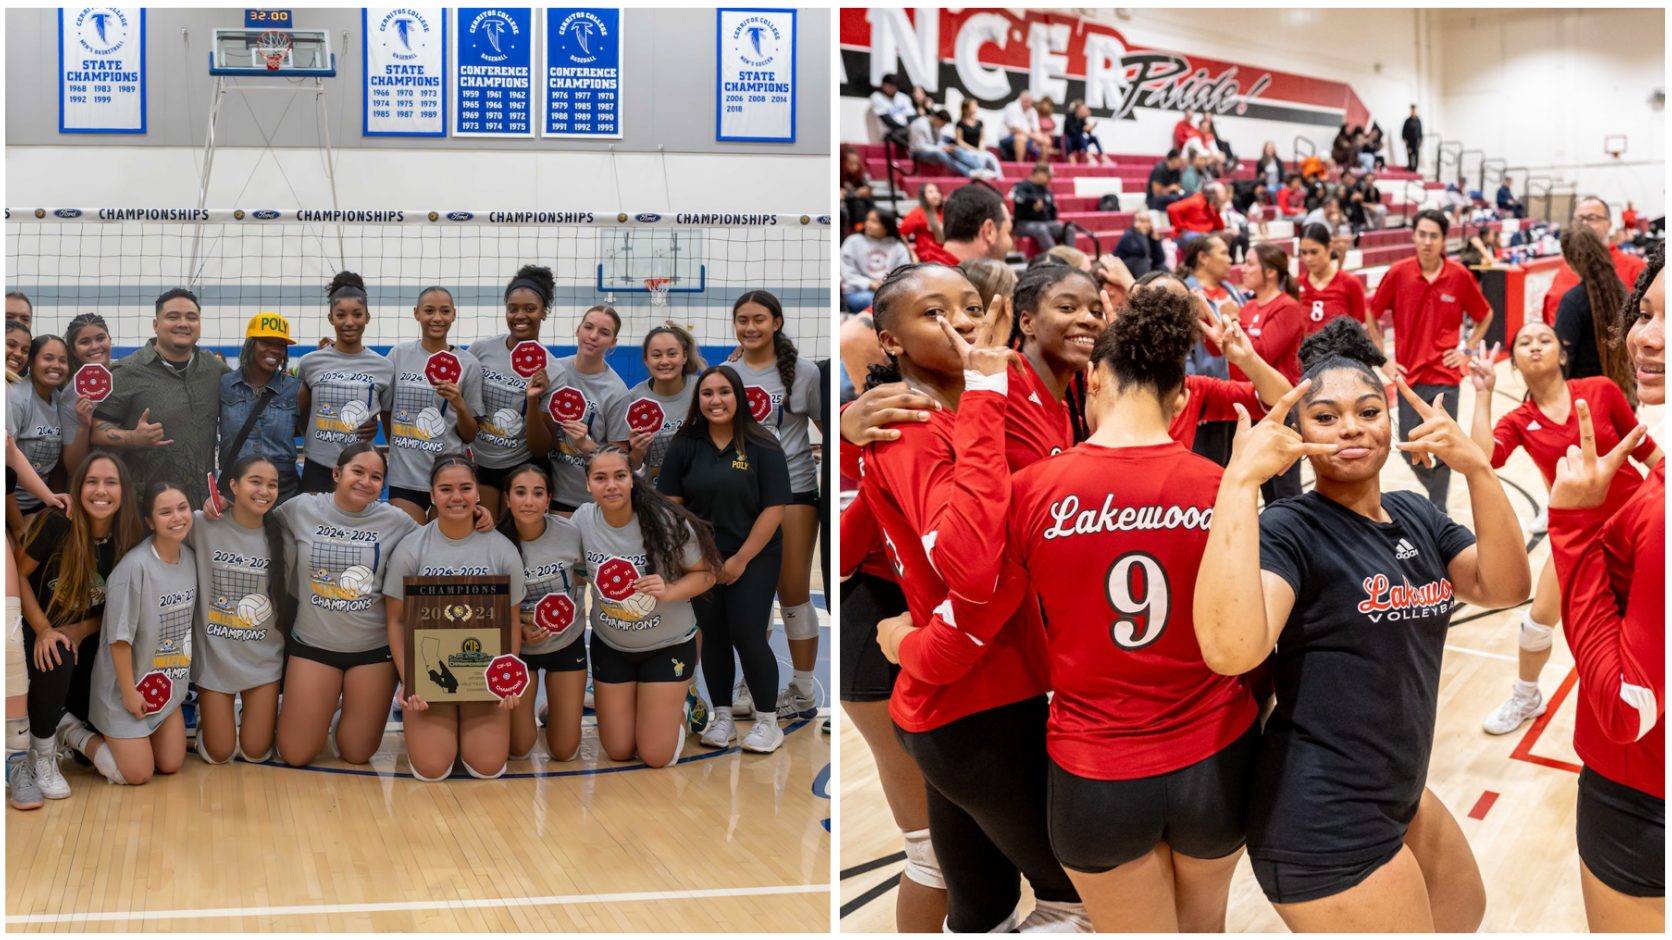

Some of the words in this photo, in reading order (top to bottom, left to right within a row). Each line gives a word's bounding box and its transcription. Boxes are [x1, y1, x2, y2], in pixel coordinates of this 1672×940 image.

[251, 12, 288, 20] 32.00
[380, 9, 406, 32] CERRITOS
[407, 9, 429, 32] COLLEGE
[470, 10, 496, 33] CERRITOS
[497, 11, 519, 35] COLLEGE
[559, 12, 584, 35] CERRITOS
[586, 12, 608, 36] COLLEGE
[733, 17, 758, 39] CERRITOS
[760, 18, 780, 40] COLLEGE
[392, 52, 418, 60] BASEBALL
[481, 53, 508, 61] BASEBALL
[570, 55, 596, 63] BASEBALL
[840, 8, 1128, 110] NCER
[83, 60, 122, 70] STATE
[386, 65, 424, 74] STATE
[67, 71, 138, 81] CHAMPIONS
[460, 66, 528, 76] CONFERENCE
[550, 67, 616, 77] CONFERENCE
[739, 71, 775, 81] STATE
[371, 76, 439, 86] CHAMPIONS
[460, 77, 528, 88] CHAMPIONS
[550, 78, 617, 89] CHAMPIONS
[725, 82, 789, 92] CHAMPIONS
[463, 90, 479, 98] 1959
[509, 91, 526, 99] 1962
[598, 92, 614, 100] 1978
[486, 101, 502, 109] 1966
[509, 112, 526, 120] 1972
[575, 113, 591, 121] 1989
[598, 113, 614, 121] 1990
[58, 209, 77, 218] Ford
[99, 209, 209, 220] CHAMPIONSHIPS
[258, 210, 276, 219] Ford
[296, 210, 404, 222] CHAMPIONSHIPS
[451, 212, 469, 220] Ford
[489, 212, 594, 223] CHAMPIONSHIPS
[639, 214, 657, 222] Ford
[676, 213, 777, 225] CHAMPIONSHIPS
[1310, 300, 1324, 322] 8
[261, 317, 288, 334] POLY
[320, 372, 374, 383] 2024-2025
[482, 369, 527, 390] 2024-202
[315, 430, 360, 443] CHAMPION
[732, 461, 748, 470] POLY
[316, 525, 378, 542] 2024-2025
[424, 567, 488, 576] 2024-2025
[420, 585, 497, 595] CHAMPIONS
[311, 594, 373, 611] CHAMPIONS
[1105, 551, 1171, 652] 9
[421, 607, 440, 620] 20
[476, 607, 495, 619] 24
[600, 612, 661, 631] CHAMPIONS
[206, 624, 267, 640] CHAMPIONS
